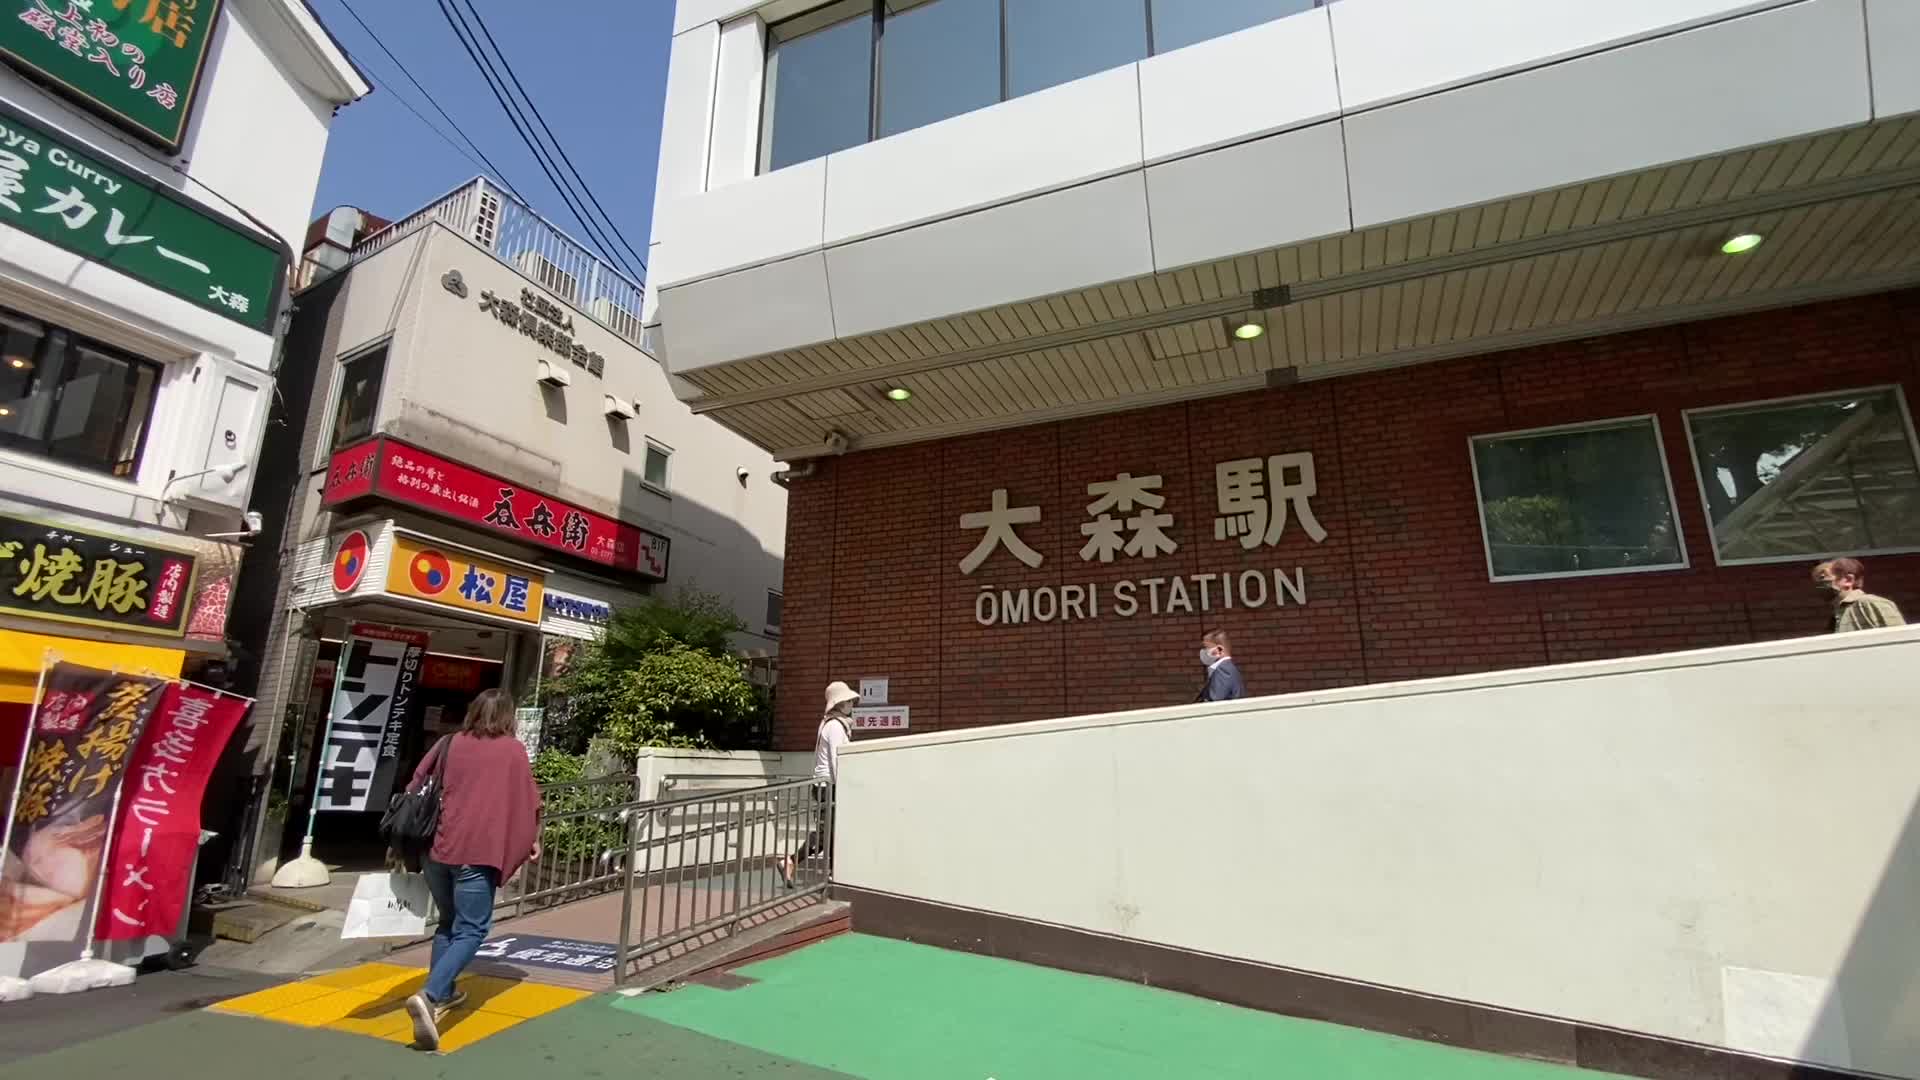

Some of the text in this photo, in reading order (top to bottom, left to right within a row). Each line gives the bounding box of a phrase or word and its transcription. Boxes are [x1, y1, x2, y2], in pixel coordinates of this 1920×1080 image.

[36, 0, 145, 64] 上初の
[48, 148, 122, 195] Curry
[208, 284, 249, 313] 大森
[958, 451, 1329, 575] 大森駅
[153, 563, 183, 619] 店内製造
[458, 563, 530, 612] 松屋
[1113, 566, 1306, 617] STATION
[317, 639, 399, 806] トンテキ
[381, 646, 423, 758] 厚切りトンテキ定食
